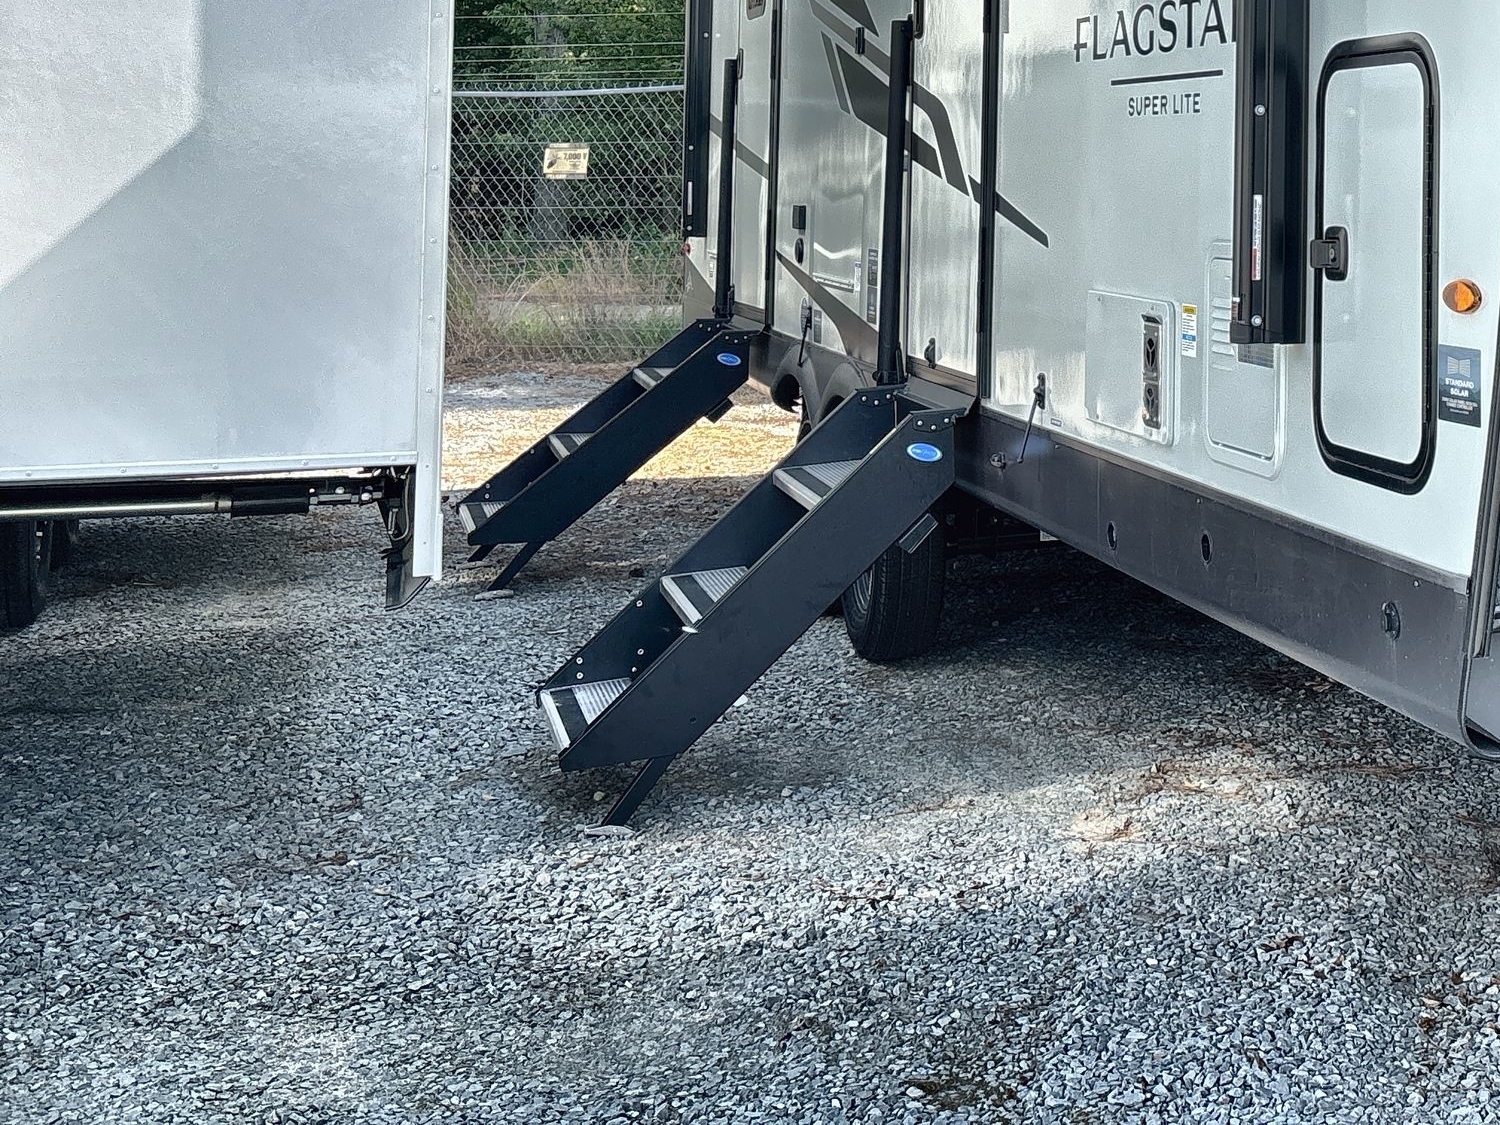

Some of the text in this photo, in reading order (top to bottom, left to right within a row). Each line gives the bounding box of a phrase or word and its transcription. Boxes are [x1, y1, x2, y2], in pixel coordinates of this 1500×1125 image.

[1128, 92, 1201, 117] SUPER LITE
[1445, 378, 1474, 389] STANDARD
[1450, 388, 1469, 397] SOLAR
